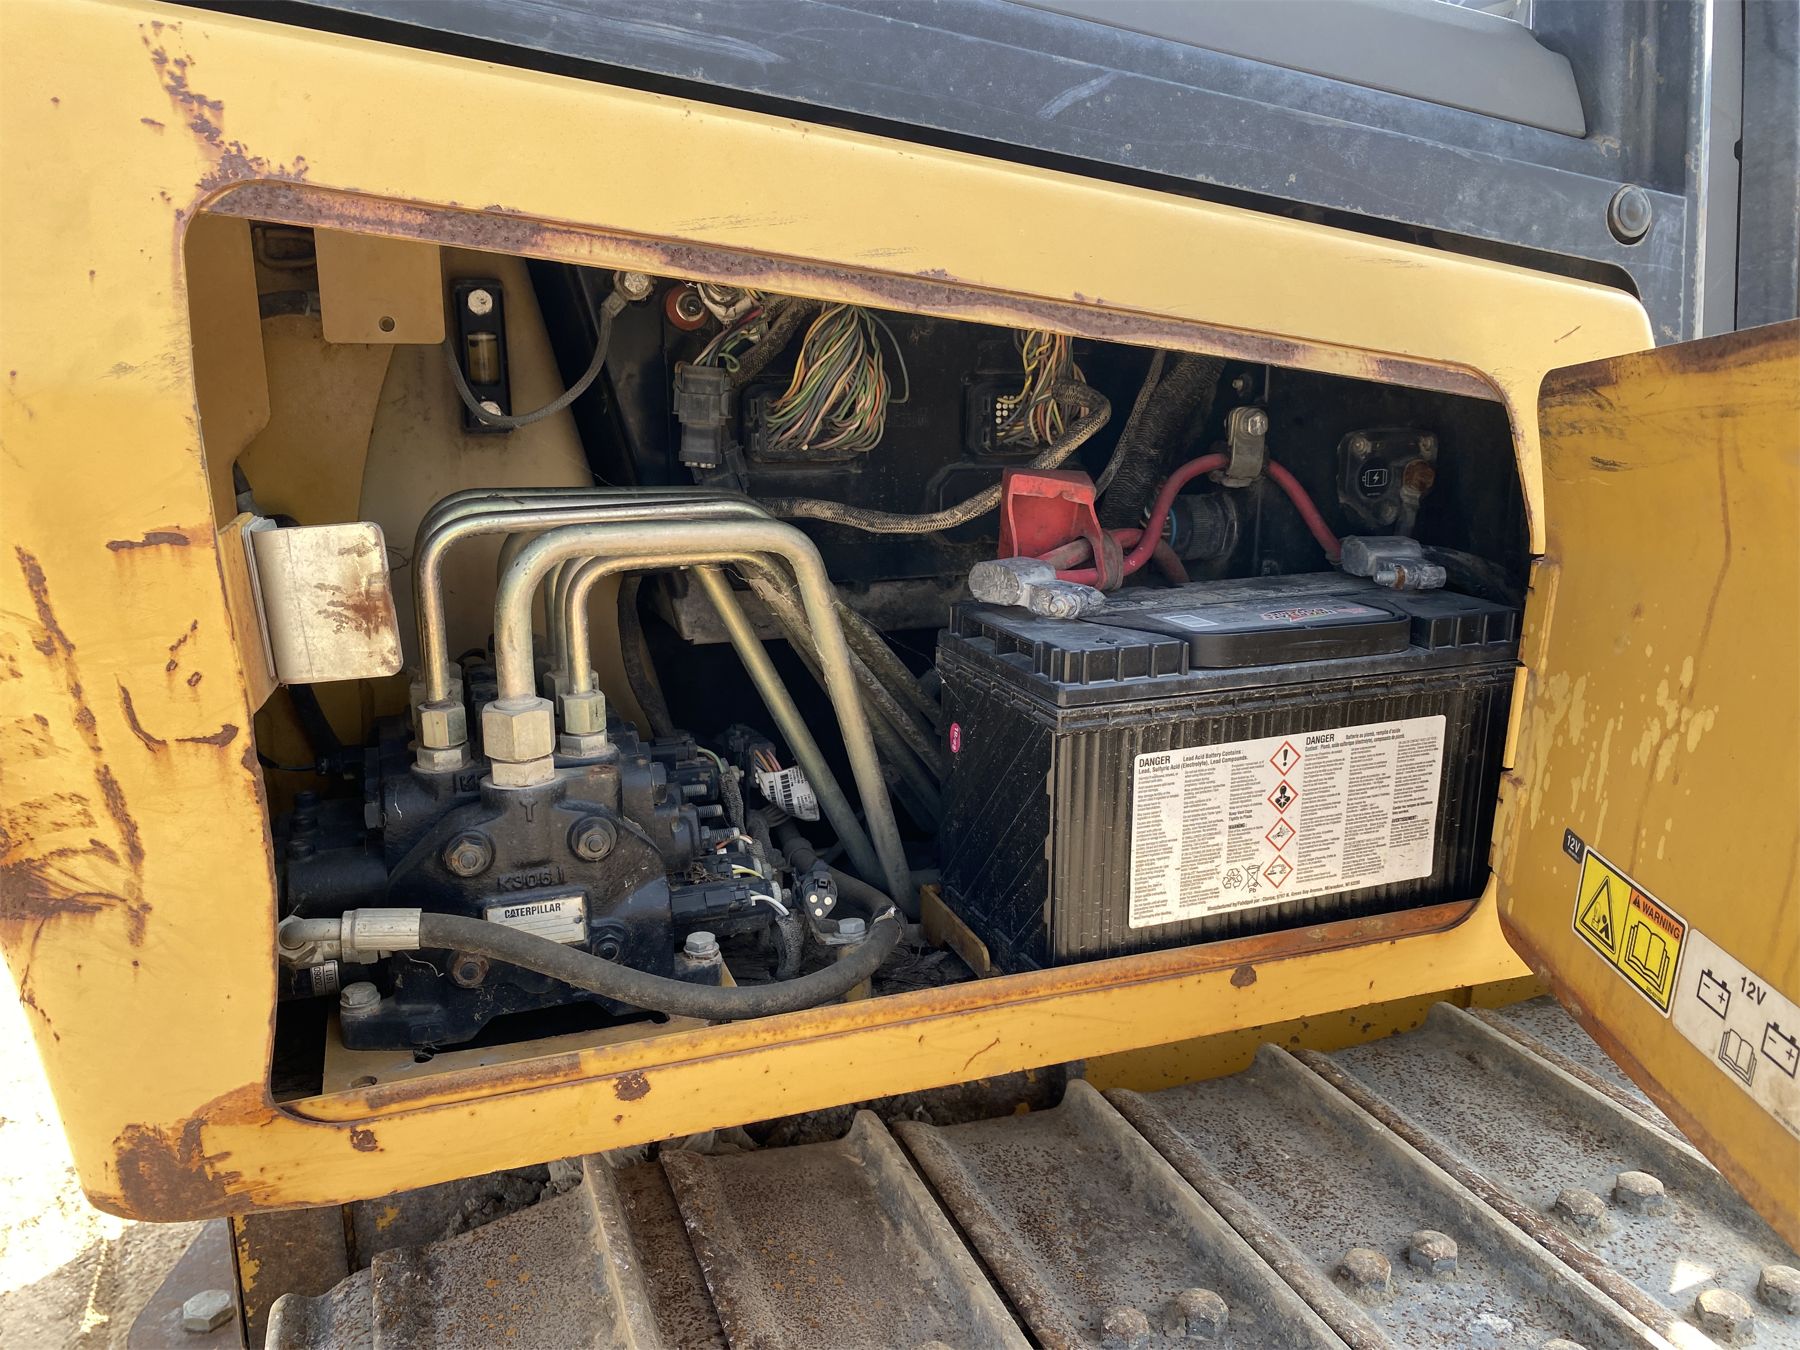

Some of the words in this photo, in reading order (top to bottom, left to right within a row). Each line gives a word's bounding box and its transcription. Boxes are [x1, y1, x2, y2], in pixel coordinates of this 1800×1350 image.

[1305, 733, 1335, 746] DANGER
[1139, 755, 1171, 768] DANGER
[1183, 754, 1195, 762] Lead
[1567, 834, 1581, 854] 12V
[504, 902, 561, 919] CATERPILLAR
[1642, 901, 1681, 940] WARNING
[1741, 976, 1767, 1006] 12V
